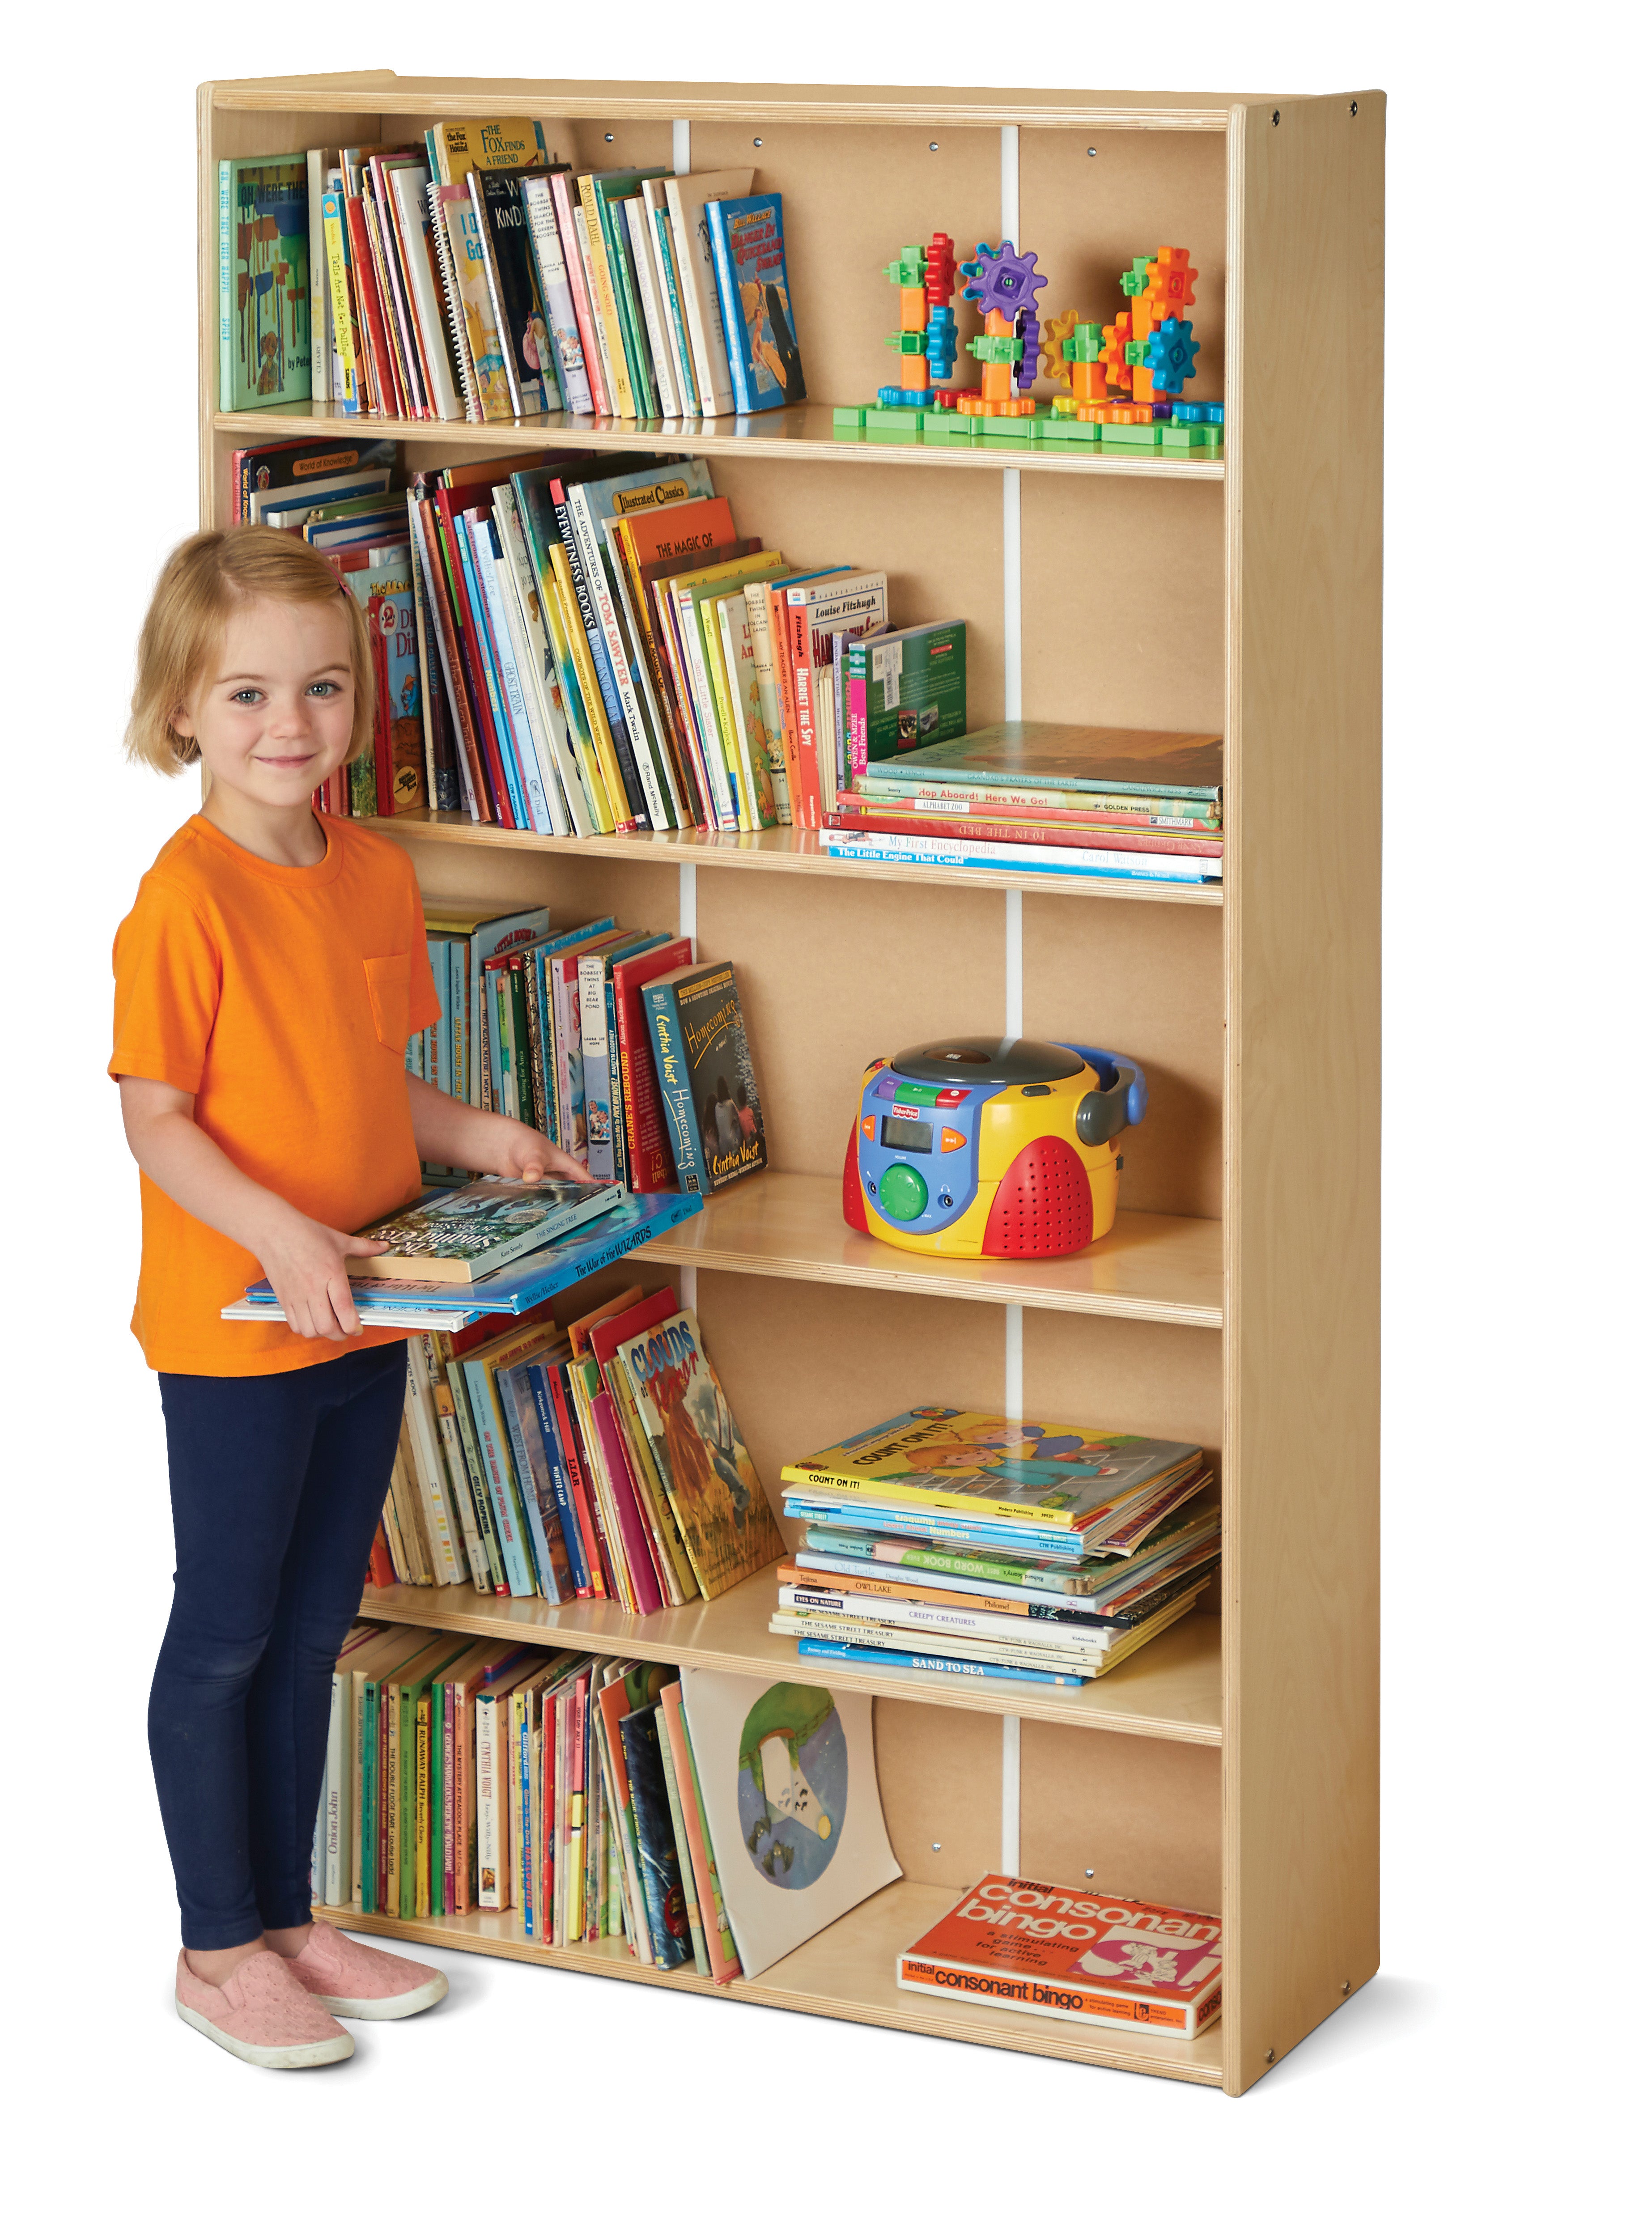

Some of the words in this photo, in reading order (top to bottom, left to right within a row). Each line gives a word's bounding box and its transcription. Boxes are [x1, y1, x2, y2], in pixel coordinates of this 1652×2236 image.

[481, 129, 504, 153] FOX
[505, 140, 525, 151] FINDS
[486, 124, 501, 136] THE
[486, 157, 491, 165] A
[492, 154, 518, 164] FRIEND
[581, 184, 595, 216] ROALD
[590, 218, 600, 246] DAHL
[734, 218, 745, 229] BILL
[747, 210, 772, 224] WALLACE
[730, 228, 764, 250] DANGER
[737, 237, 782, 266] QUICKSAND
[756, 252, 783, 272] SWAMP
[598, 264, 608, 293] GOING
[603, 293, 613, 315] SOLO
[340, 327, 348, 356] Pulling
[299, 459, 315, 471] World
[316, 458, 322, 469] of
[323, 454, 353, 468] Knowledge
[618, 493, 654, 513] Illustrated
[655, 485, 684, 504] Classics
[573, 499, 584, 517] THE
[579, 519, 600, 577] ADVENTURES
[594, 578, 604, 591] OF
[656, 541, 673, 558] THE
[675, 535, 699, 554] MAGIC
[702, 532, 713, 547] OF
[555, 505, 584, 582] EYEWITNESS
[576, 584, 596, 628] BOOKS
[815, 606, 840, 619] Louise
[842, 596, 876, 613] Fitzhugh
[599, 594, 614, 625] TOM
[607, 630, 630, 686] SAWYER
[794, 615, 805, 658] Fitzhugh
[502, 661, 518, 690] GHOST
[694, 658, 706, 682] Sam's
[778, 641, 784, 650] MY
[783, 685, 789, 694] AN
[698, 685, 710, 709] Little
[795, 667, 812, 707] HARRIET
[509, 689, 524, 715] TRAIN
[621, 691, 634, 714] Mark
[627, 714, 641, 741] Twain
[704, 712, 715, 738] Sister
[799, 709, 811, 726] THE
[800, 728, 814, 746] SPY
[918, 788, 937, 798] Hop
[941, 789, 979, 801] Aboard!
[985, 793, 1007, 803] Here
[1011, 795, 1026, 803] We
[1030, 797, 1048, 805] Go!
[922, 801, 950, 810] ALPHABET
[1158, 816, 1192, 827] SMITHMARK
[838, 847, 855, 857] The
[857, 849, 881, 858] Little
[882, 850, 913, 861] Engine
[914, 853, 936, 862] That
[888, 836, 903, 849] My
[905, 836, 927, 849] First
[930, 840, 996, 855] Encyclopedia
[1082, 850, 1109, 863] Carol
[1112, 853, 1147, 866] Watson
[684, 1000, 741, 1054] Homecoming
[621, 1052, 632, 1102] REBOUND
[626, 1105, 637, 1150] CRANE'S
[536, 1229, 546, 1239] THE
[546, 1220, 565, 1236] SINGING
[565, 1214, 577, 1226] TREE
[575, 1261, 586, 1278] The
[586, 1256, 599, 1273] War
[599, 1253, 606, 1266] of
[606, 1246, 616, 1262] the
[616, 1226, 652, 1256] WIZARDS
[631, 1320, 695, 1383] CLOUDS
[512, 1425, 523, 1449] WEST
[852, 1443, 905, 1465] COUNT
[901, 1431, 924, 1443] ON
[923, 1423, 953, 1433] IT!
[517, 1450, 530, 1476] FROM
[568, 1459, 580, 1487] LIAR
[472, 1475, 483, 1498] GILLY
[523, 1476, 536, 1503] HOME
[808, 1474, 834, 1485] COUNT
[837, 1478, 847, 1487] ON
[850, 1481, 860, 1489] IT!
[477, 1499, 491, 1534] HOPKINS
[906, 1524, 927, 1532] About
[930, 1527, 970, 1539] Numbers
[1050, 1544, 1074, 1553] Publishing
[922, 1555, 951, 1568] BOOK
[954, 1561, 984, 1574] WORD
[799, 1574, 818, 1584] Tejima
[1003, 1570, 1023, 1579] Scarry's
[855, 1582, 873, 1591] OWL
[874, 1585, 892, 1593] LAKE
[796, 1595, 808, 1604] EYES
[820, 1598, 842, 1608] NATURE
[985, 1600, 1010, 1610] Philomel
[909, 1611, 934, 1621] CREEPY
[936, 1614, 976, 1626] CREATURES
[807, 1631, 830, 1639] SESAME
[855, 1638, 886, 1646] TREASURY
[913, 1659, 944, 1670] SAND
[945, 1662, 961, 1673] TO
[963, 1665, 985, 1676] SEA
[480, 1741, 492, 1774] CYNTHIA
[481, 1777, 492, 1799] VOIGT
[330, 1791, 338, 1819] John
[327, 1821, 338, 1854] Onion
[1007, 1879, 1055, 1893] initial
[956, 1898, 1096, 1940] bingo
[979, 1884, 1222, 1943] consonan
[976, 1941, 997, 1949] for
[1000, 1947, 1041, 1957] active
[992, 1939, 1032, 1949] game
[999, 1933, 1079, 1952] stimulating
[908, 1961, 935, 1975] initial
[989, 1951, 1048, 1966] learning
[935, 1971, 1028, 2000] consonant
[1032, 1983, 1083, 2011] bingo
